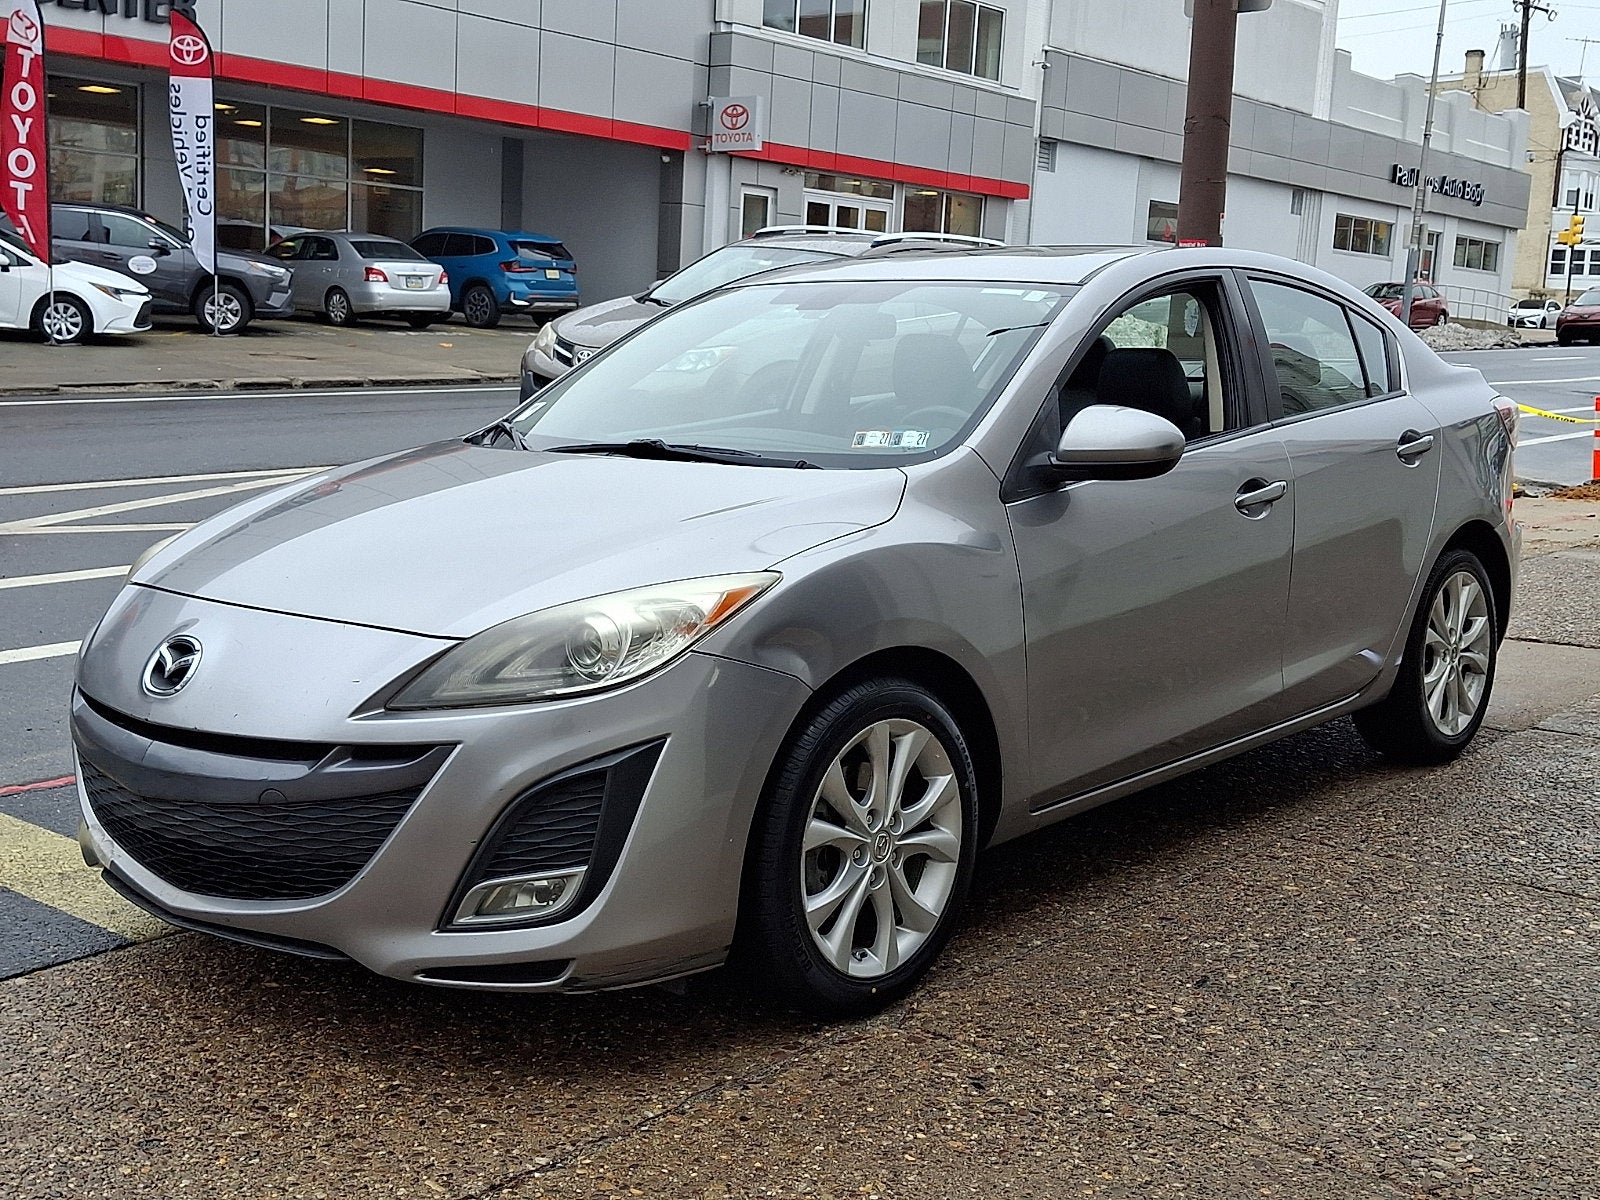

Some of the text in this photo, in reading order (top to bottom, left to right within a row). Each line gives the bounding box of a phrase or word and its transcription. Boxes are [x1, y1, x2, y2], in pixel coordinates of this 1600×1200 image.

[715, 133, 753, 143] TOYOTA
[1392, 164, 1419, 187] Paul
[1442, 176, 1463, 198] Auto
[1464, 180, 1486, 207] Body
